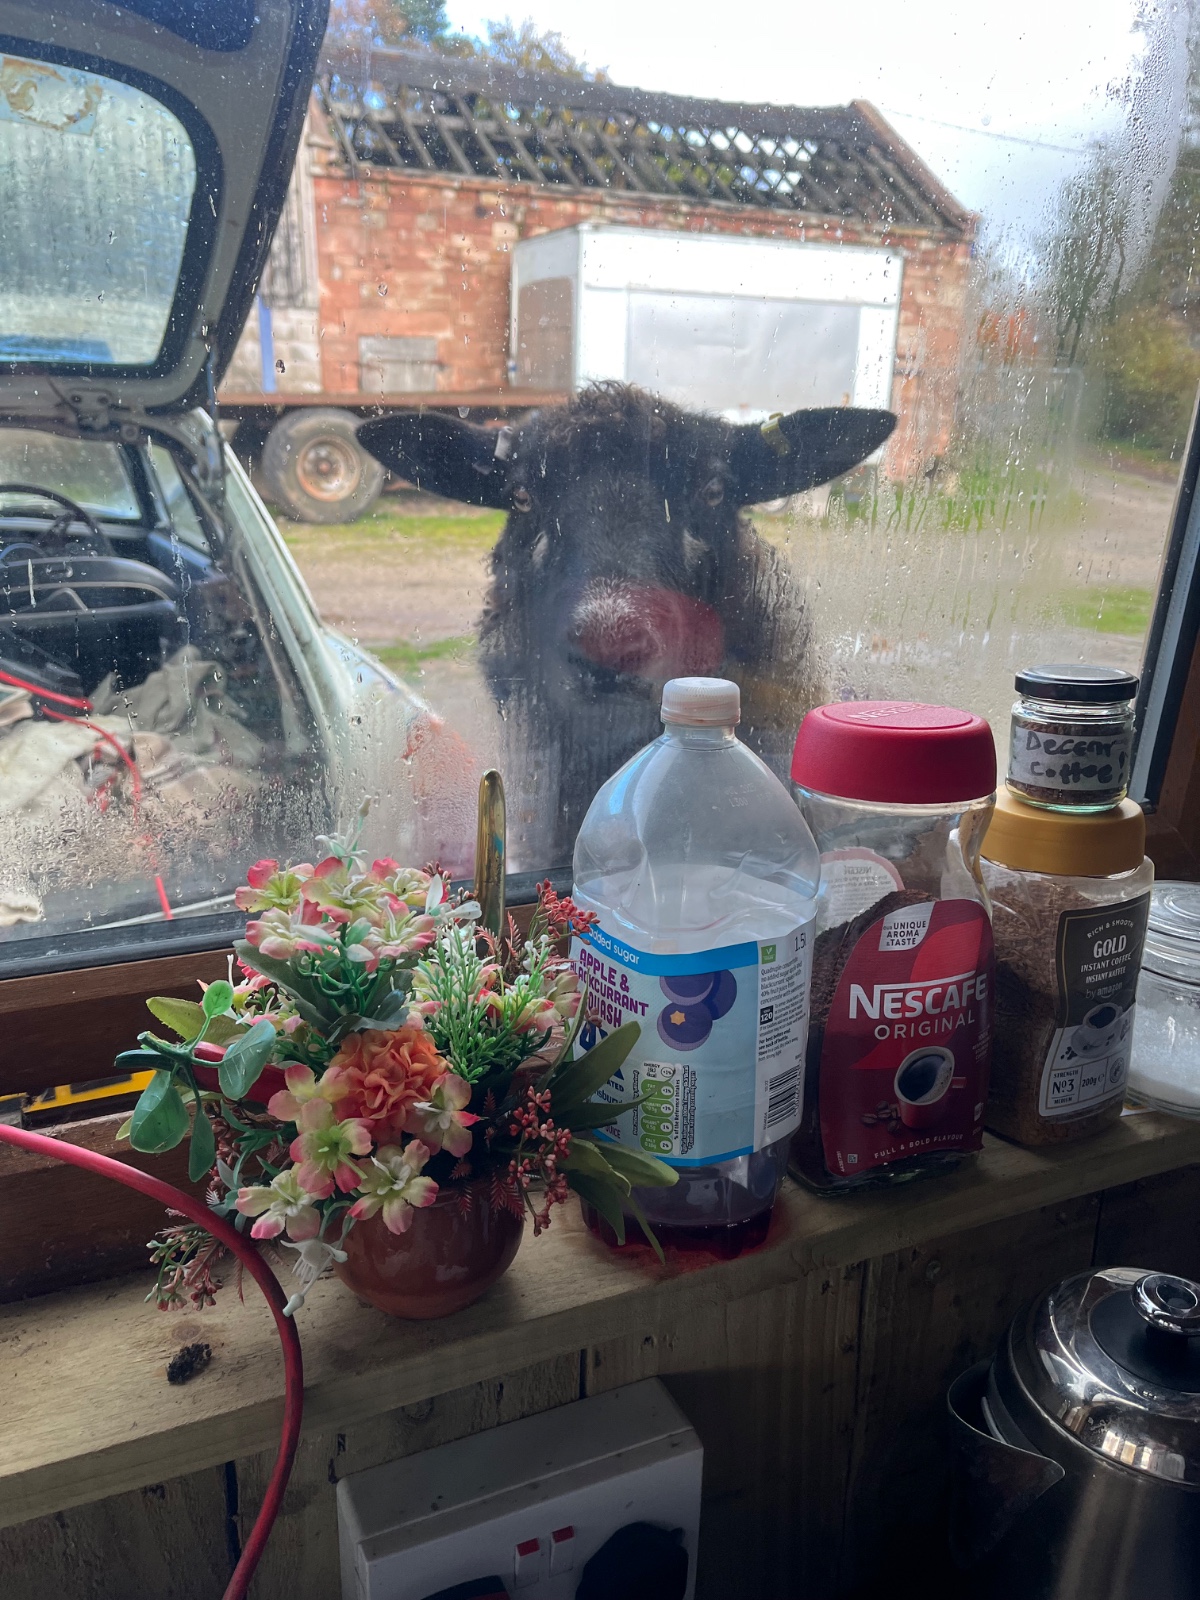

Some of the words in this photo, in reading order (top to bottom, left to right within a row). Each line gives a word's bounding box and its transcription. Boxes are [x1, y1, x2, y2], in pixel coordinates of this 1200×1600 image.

[886, 929, 920, 938] AROMA
[893, 920, 927, 930] UNIQUE
[1086, 924, 1104, 939] RICH
[1111, 919, 1134, 929] SMOOTH
[890, 937, 917, 946] TASTE
[1093, 934, 1127, 959] GOLD
[613, 944, 640, 965] sugar
[1080, 959, 1111, 973] INSTANT
[1110, 952, 1132, 967] COFFEE
[580, 948, 617, 987] APPLE
[619, 973, 630, 993] &
[1085, 971, 1108, 984] INSTANT
[1085, 988, 1097, 1000] by
[1097, 982, 1123, 997] amazon
[588, 990, 622, 1028] QUASH
[760, 1011, 773, 1022] 120
[873, 1010, 975, 1040] ORIGINAL
[1053, 1069, 1079, 1079] STRENGTH
[1081, 1076, 1097, 1088] 200g
[1054, 1097, 1073, 1105] MEDIUM
[873, 1147, 897, 1159] FULL
[909, 1137, 931, 1148] BOLD
[933, 1134, 964, 1142] FLAVOUR
